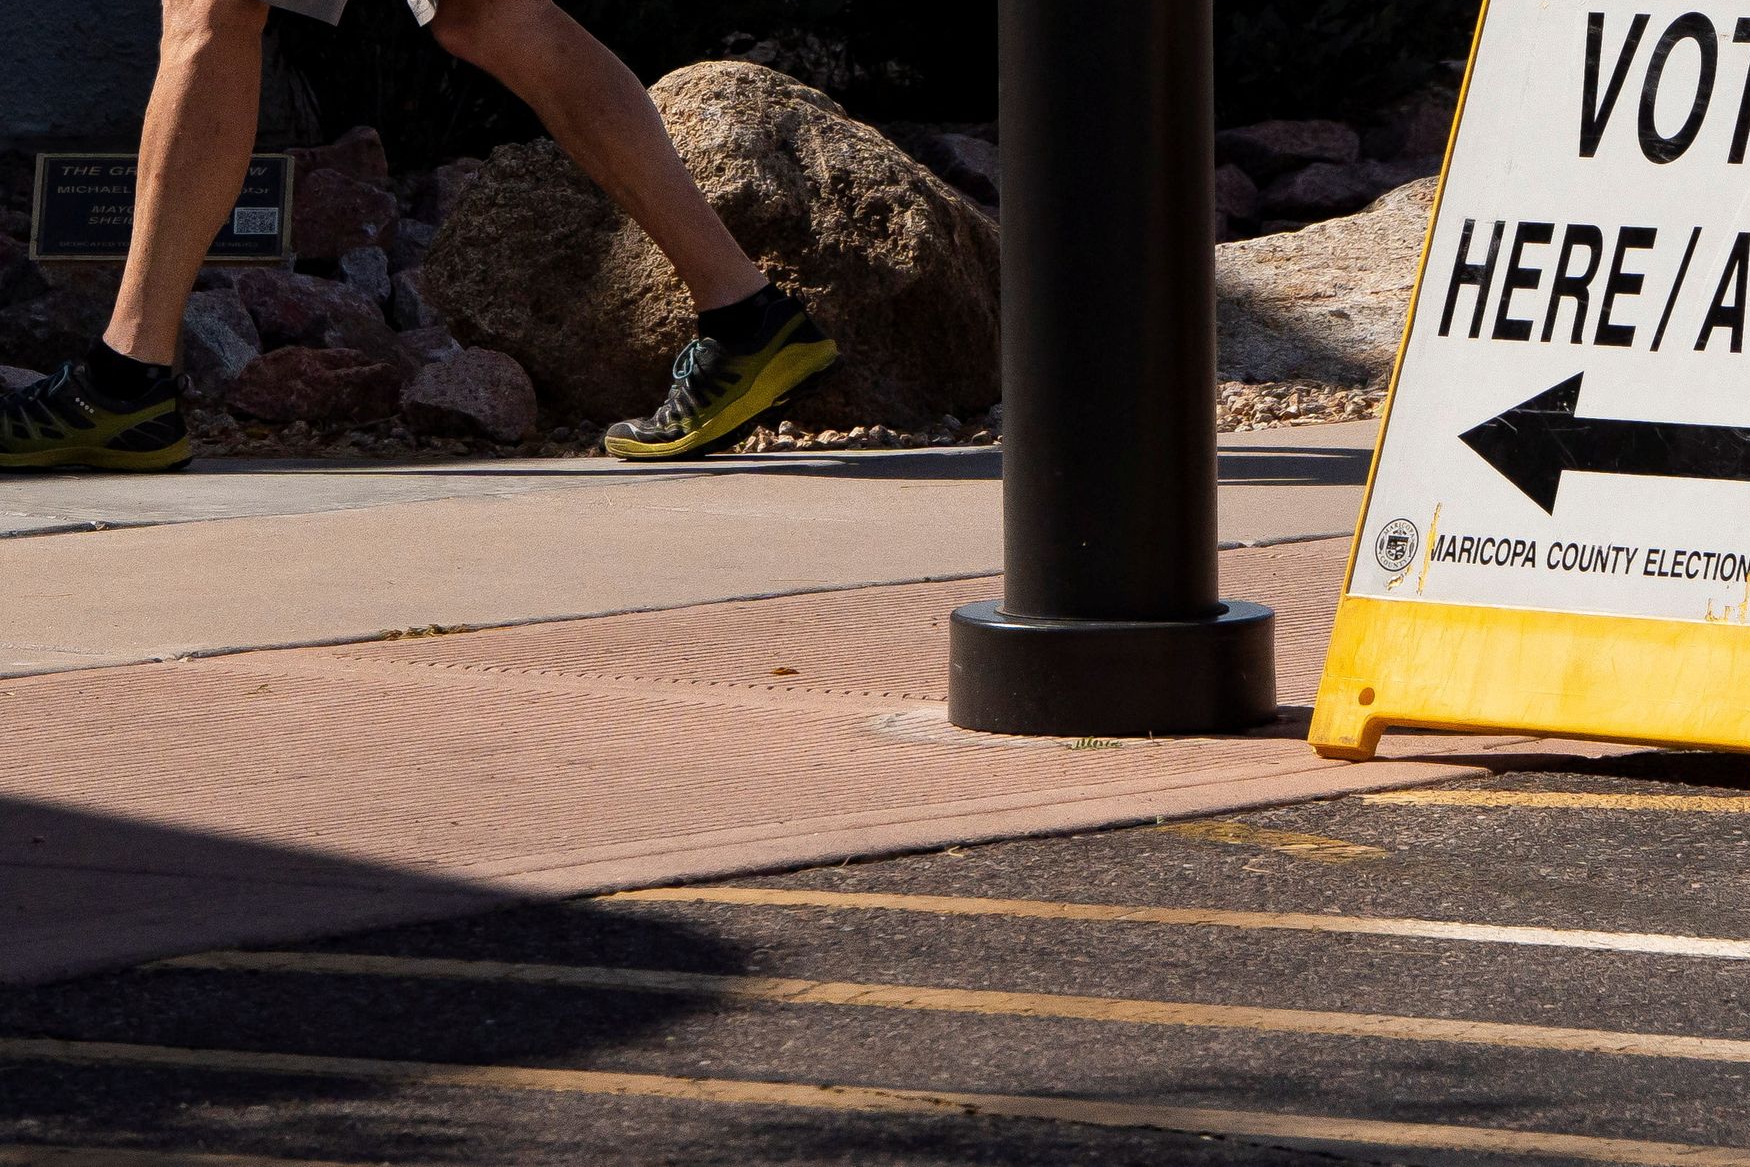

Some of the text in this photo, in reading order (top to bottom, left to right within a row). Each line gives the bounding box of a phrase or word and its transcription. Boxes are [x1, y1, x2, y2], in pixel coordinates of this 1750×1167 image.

[60, 165, 103, 177] THE
[57, 185, 133, 194] MICHAEL
[1546, 542, 1638, 575] COUNTY
